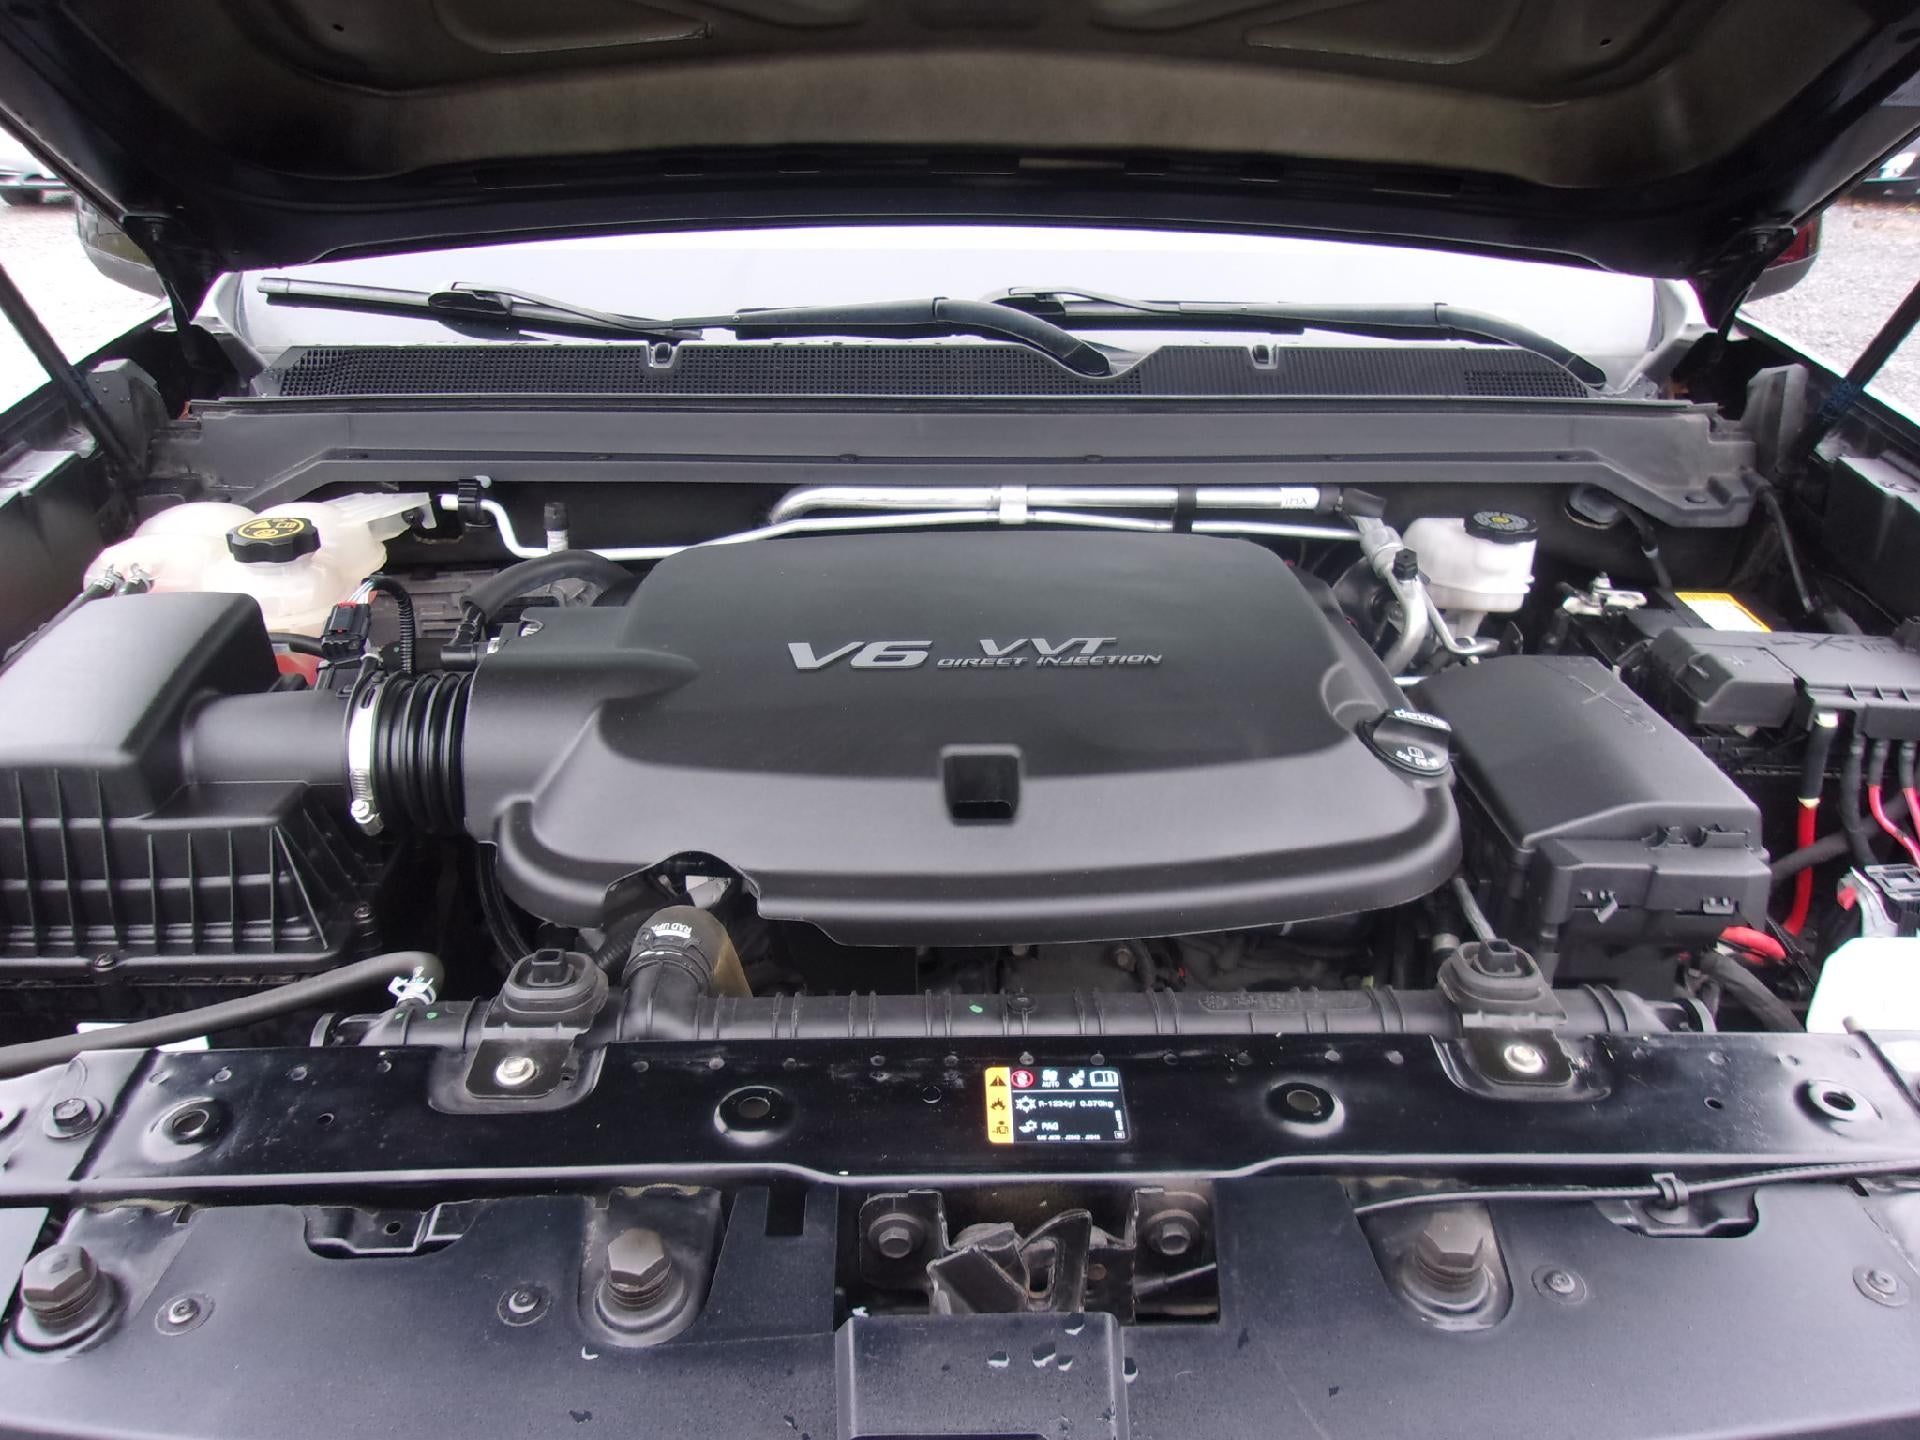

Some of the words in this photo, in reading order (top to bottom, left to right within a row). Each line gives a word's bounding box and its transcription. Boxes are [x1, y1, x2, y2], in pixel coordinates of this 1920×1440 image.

[787, 639, 933, 670] V6
[979, 637, 1118, 656] VVT
[937, 656, 1028, 668] DIRECT
[1036, 654, 1162, 666] INJECTION
